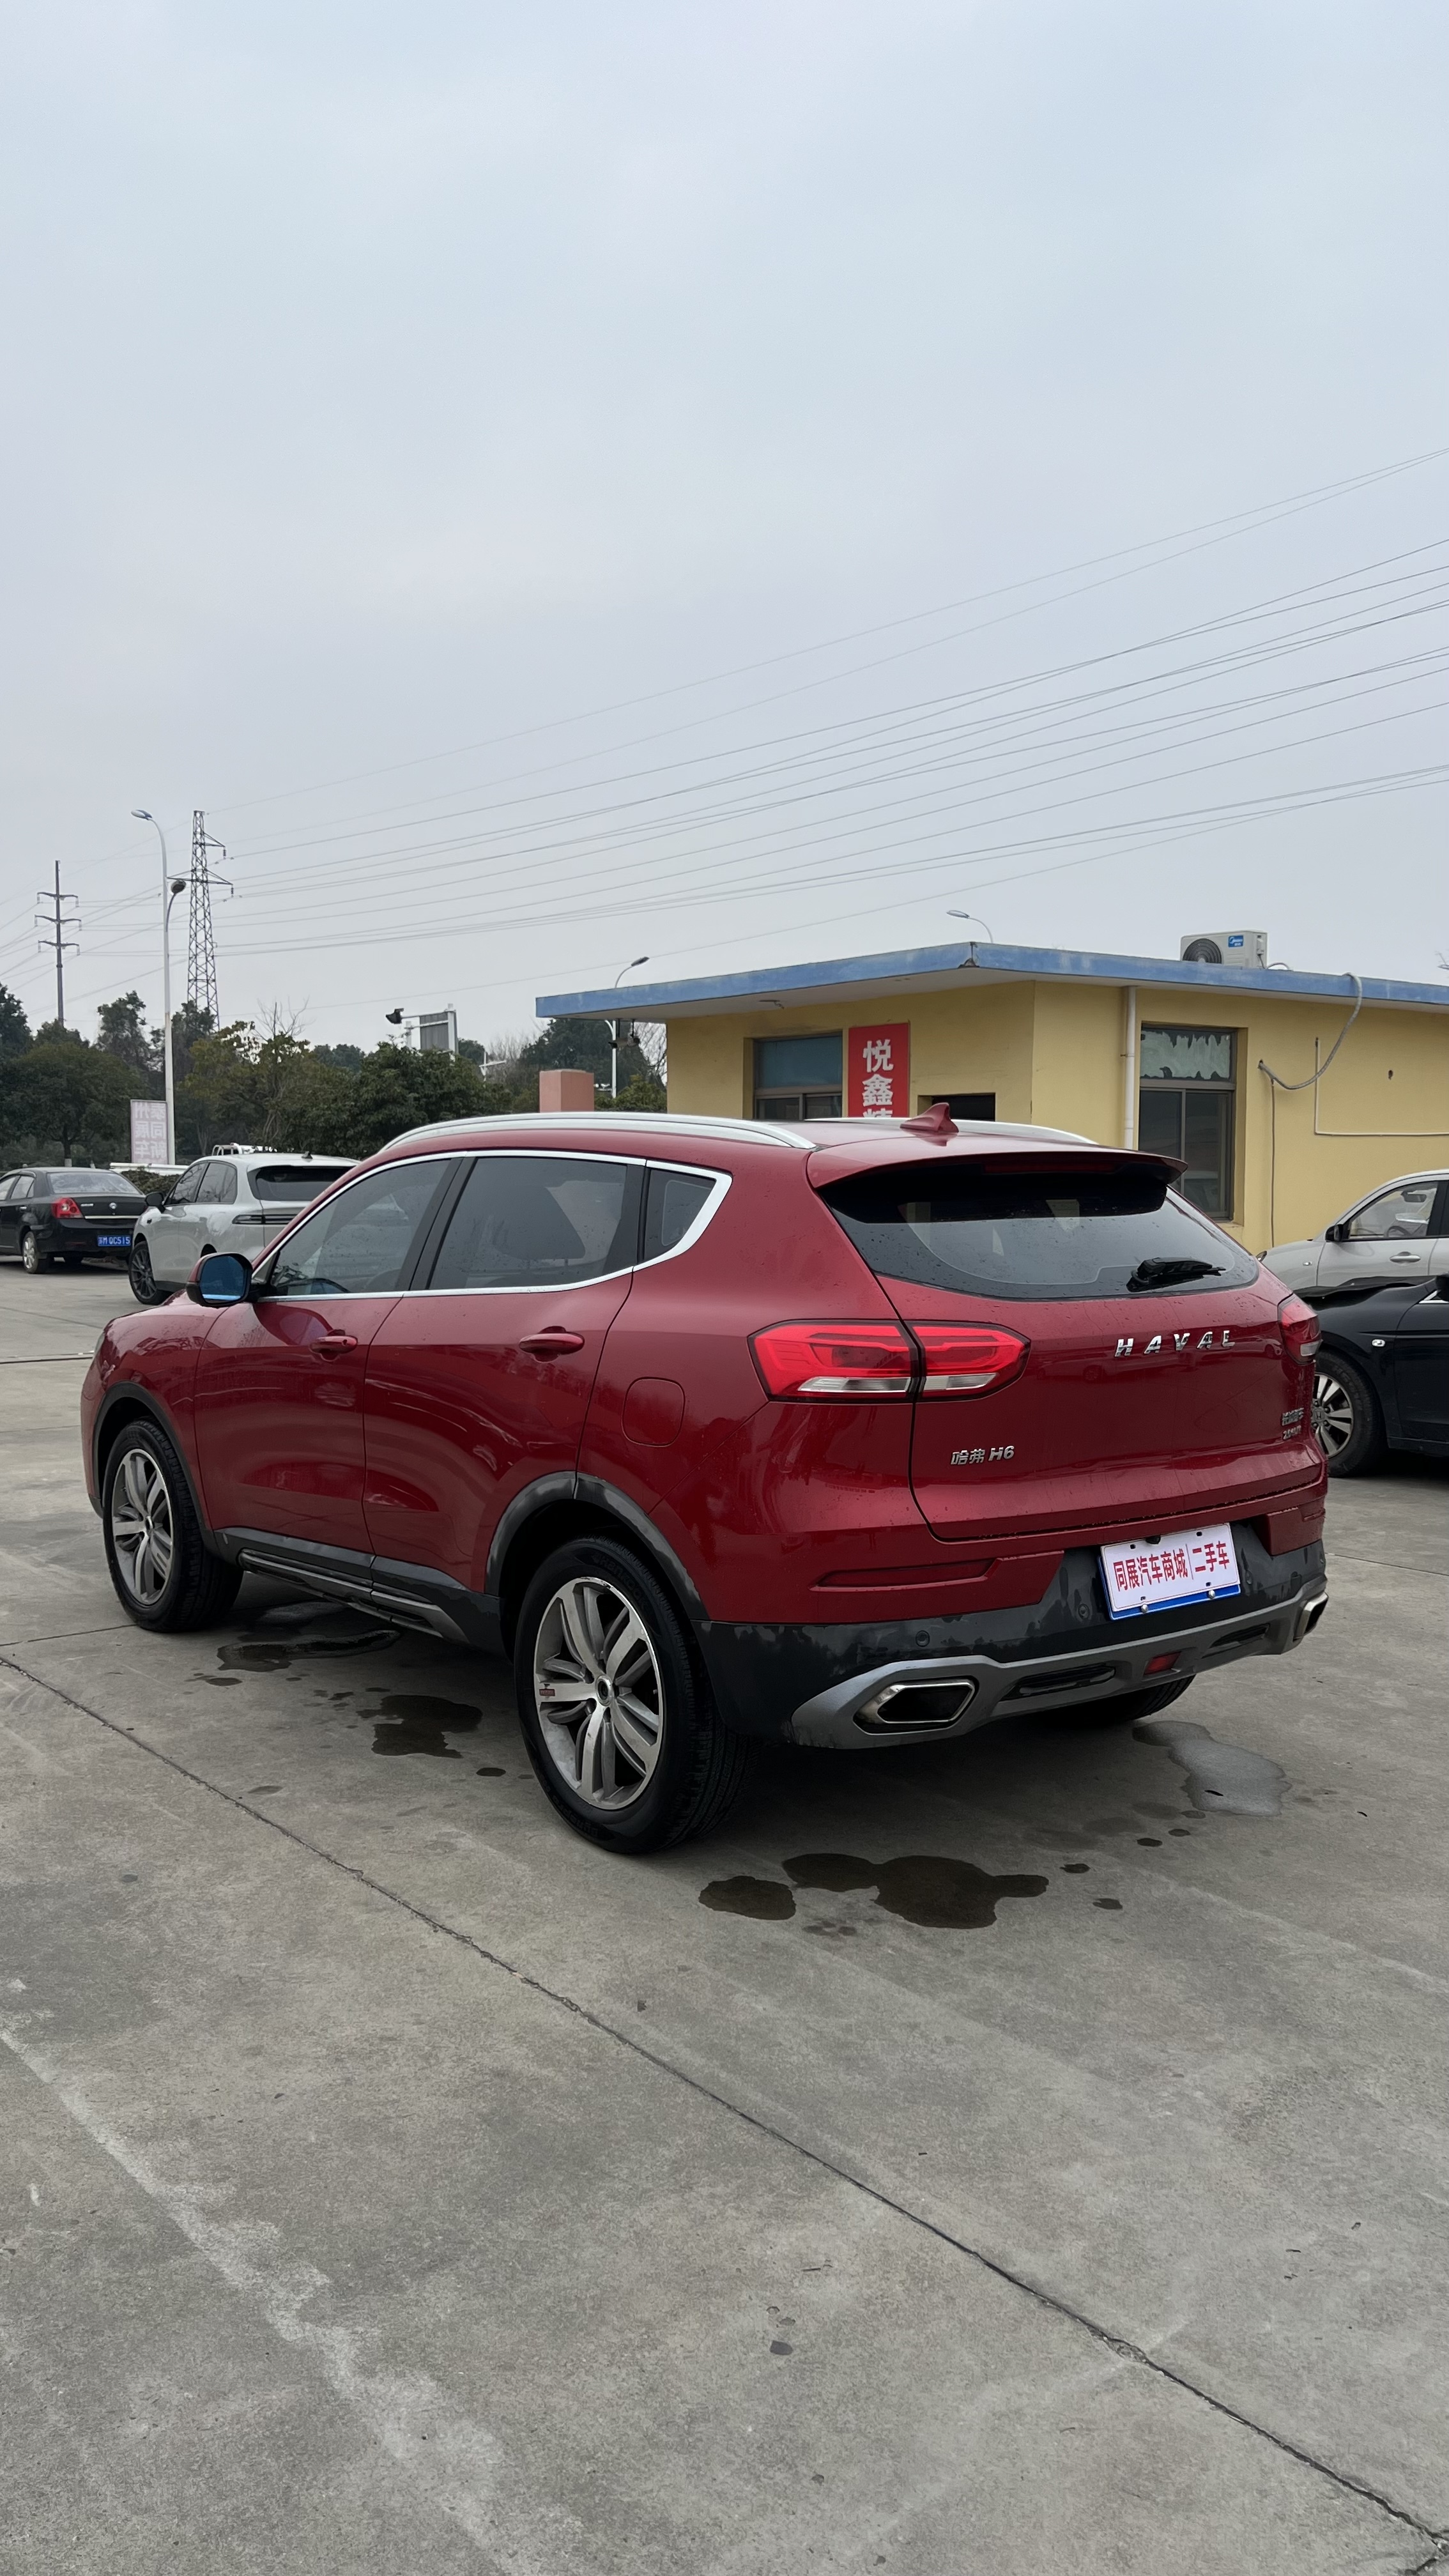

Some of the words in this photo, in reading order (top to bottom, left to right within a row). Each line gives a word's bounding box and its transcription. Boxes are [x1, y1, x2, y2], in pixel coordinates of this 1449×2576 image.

[862, 1039, 894, 1117] 悦鑫
[1114, 1330, 1236, 1357] HAVAL
[950, 1448, 985, 1465] 哈弗
[988, 1446, 1015, 1461] H6
[1113, 1548, 1188, 1591] 同展汽车商城
[1192, 1540, 1230, 1572] 二手车
